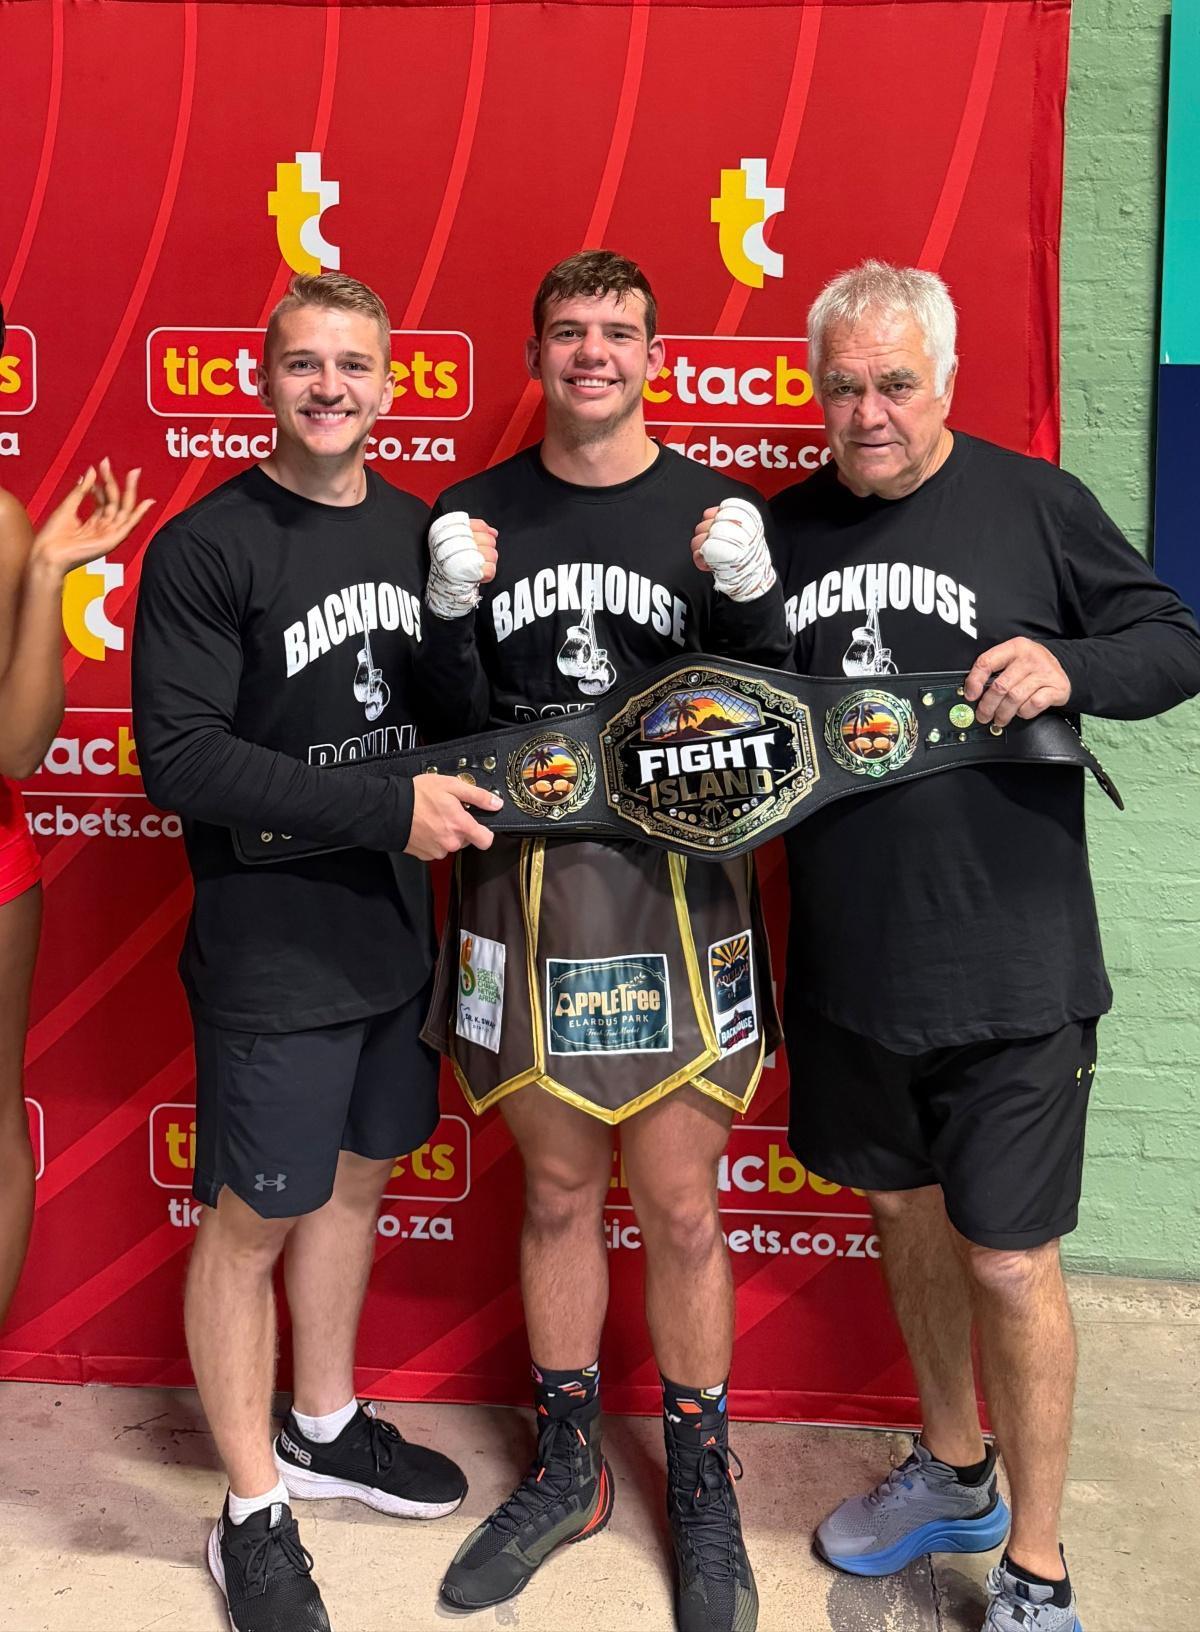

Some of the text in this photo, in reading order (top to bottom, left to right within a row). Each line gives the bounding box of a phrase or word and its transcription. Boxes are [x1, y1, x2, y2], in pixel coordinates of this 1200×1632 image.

[283, 581, 422, 679] BACKHOUS
[491, 562, 688, 648] BACKHOUSE
[784, 562, 978, 640] BACKHOUSE
[637, 733, 776, 785] FIGHT
[649, 768, 774, 809] ISLAND
[569, 1014, 649, 1028] ELARDUS PARK
